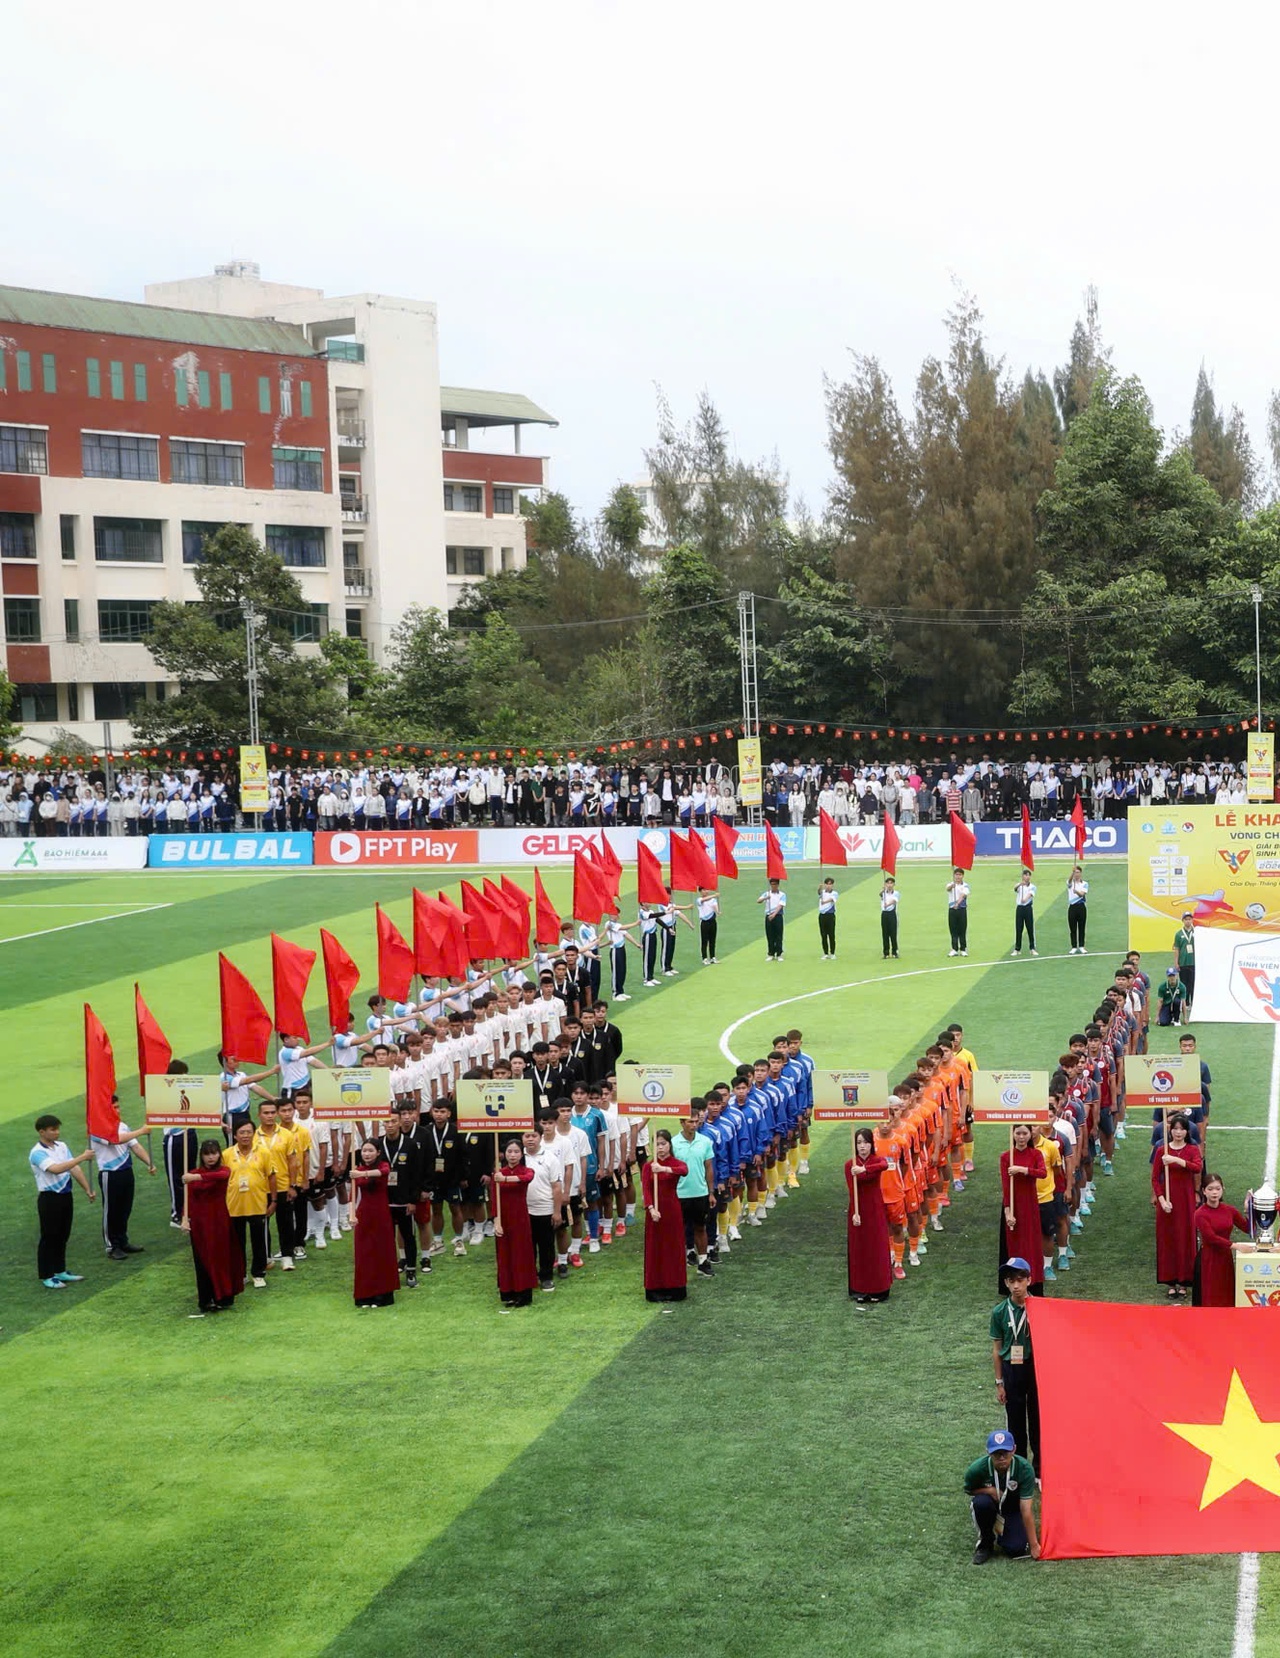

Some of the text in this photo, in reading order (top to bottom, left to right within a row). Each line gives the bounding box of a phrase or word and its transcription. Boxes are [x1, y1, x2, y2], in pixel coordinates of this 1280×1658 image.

[1215, 809, 1236, 826] LỄ
[162, 838, 301, 861] BULBAL
[365, 838, 458, 861] FPT Play
[522, 834, 597, 855] GELEX
[869, 838, 933, 852] Vank
